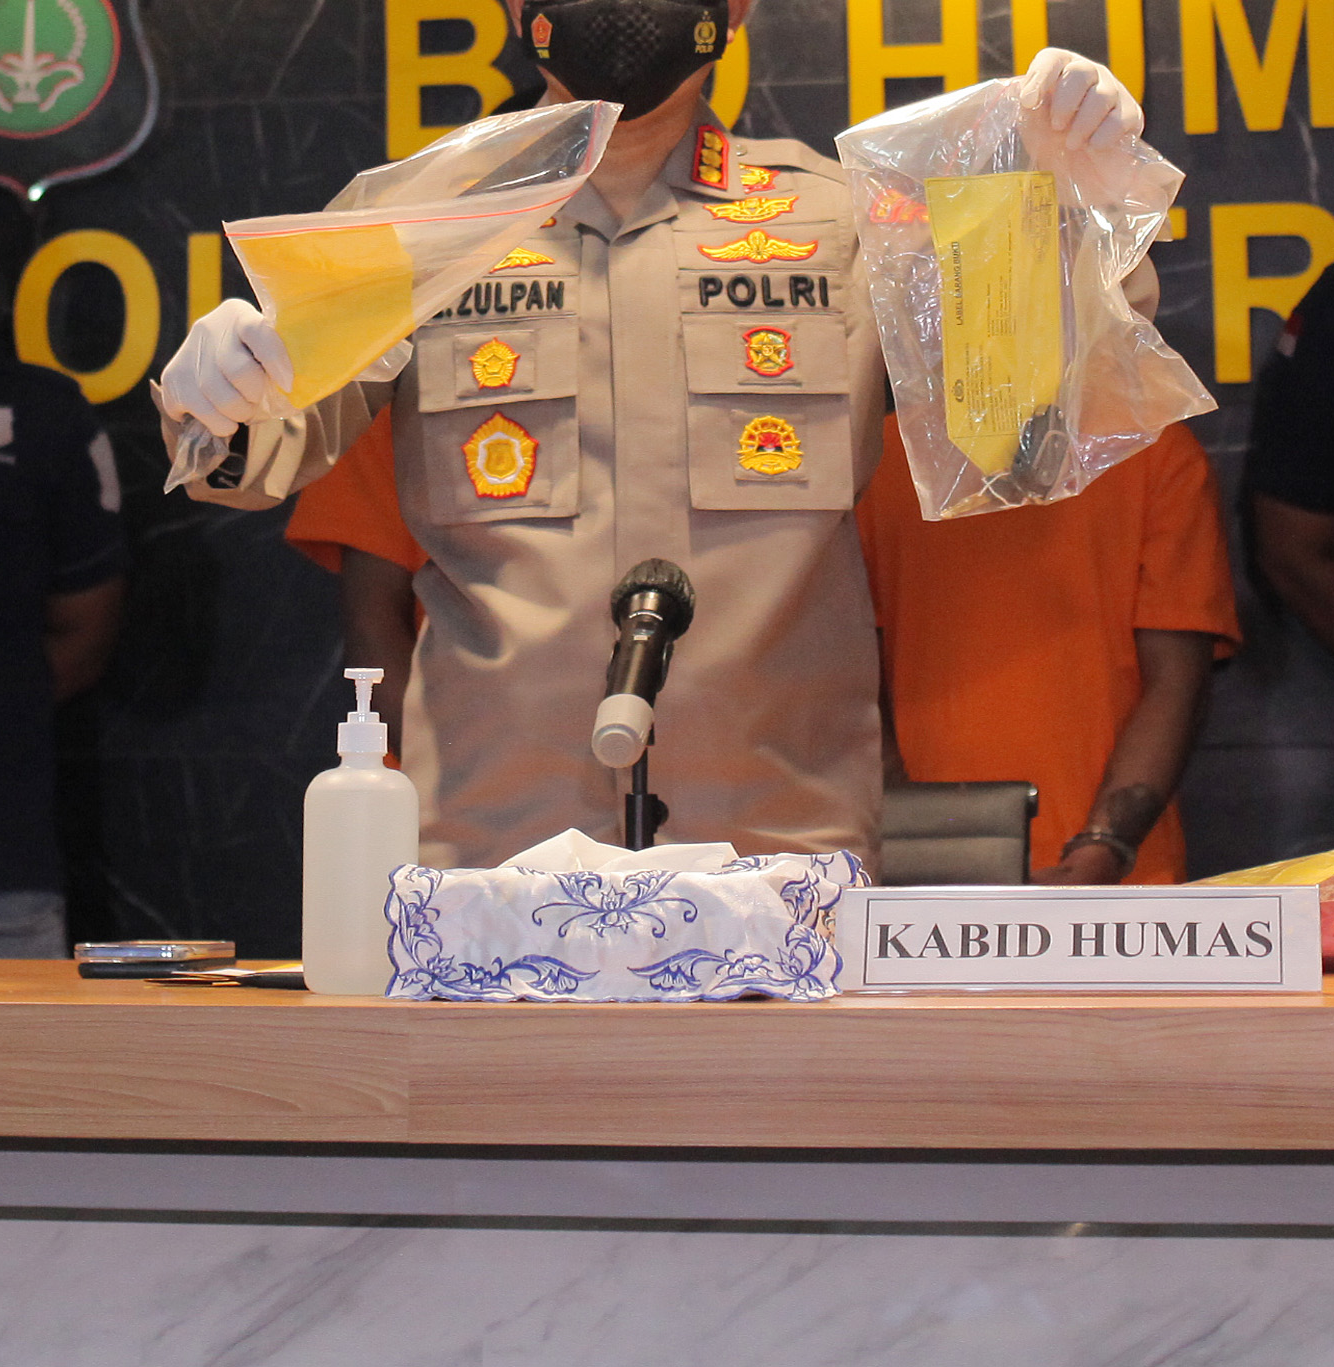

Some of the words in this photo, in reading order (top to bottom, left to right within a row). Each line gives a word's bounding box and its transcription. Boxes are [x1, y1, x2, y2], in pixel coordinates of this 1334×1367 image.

[431, 280, 565, 319] .ZULPAN
[698, 275, 829, 308] POLRI
[873, 922, 1052, 960] KABID
[1067, 920, 1274, 958] HUMAS
